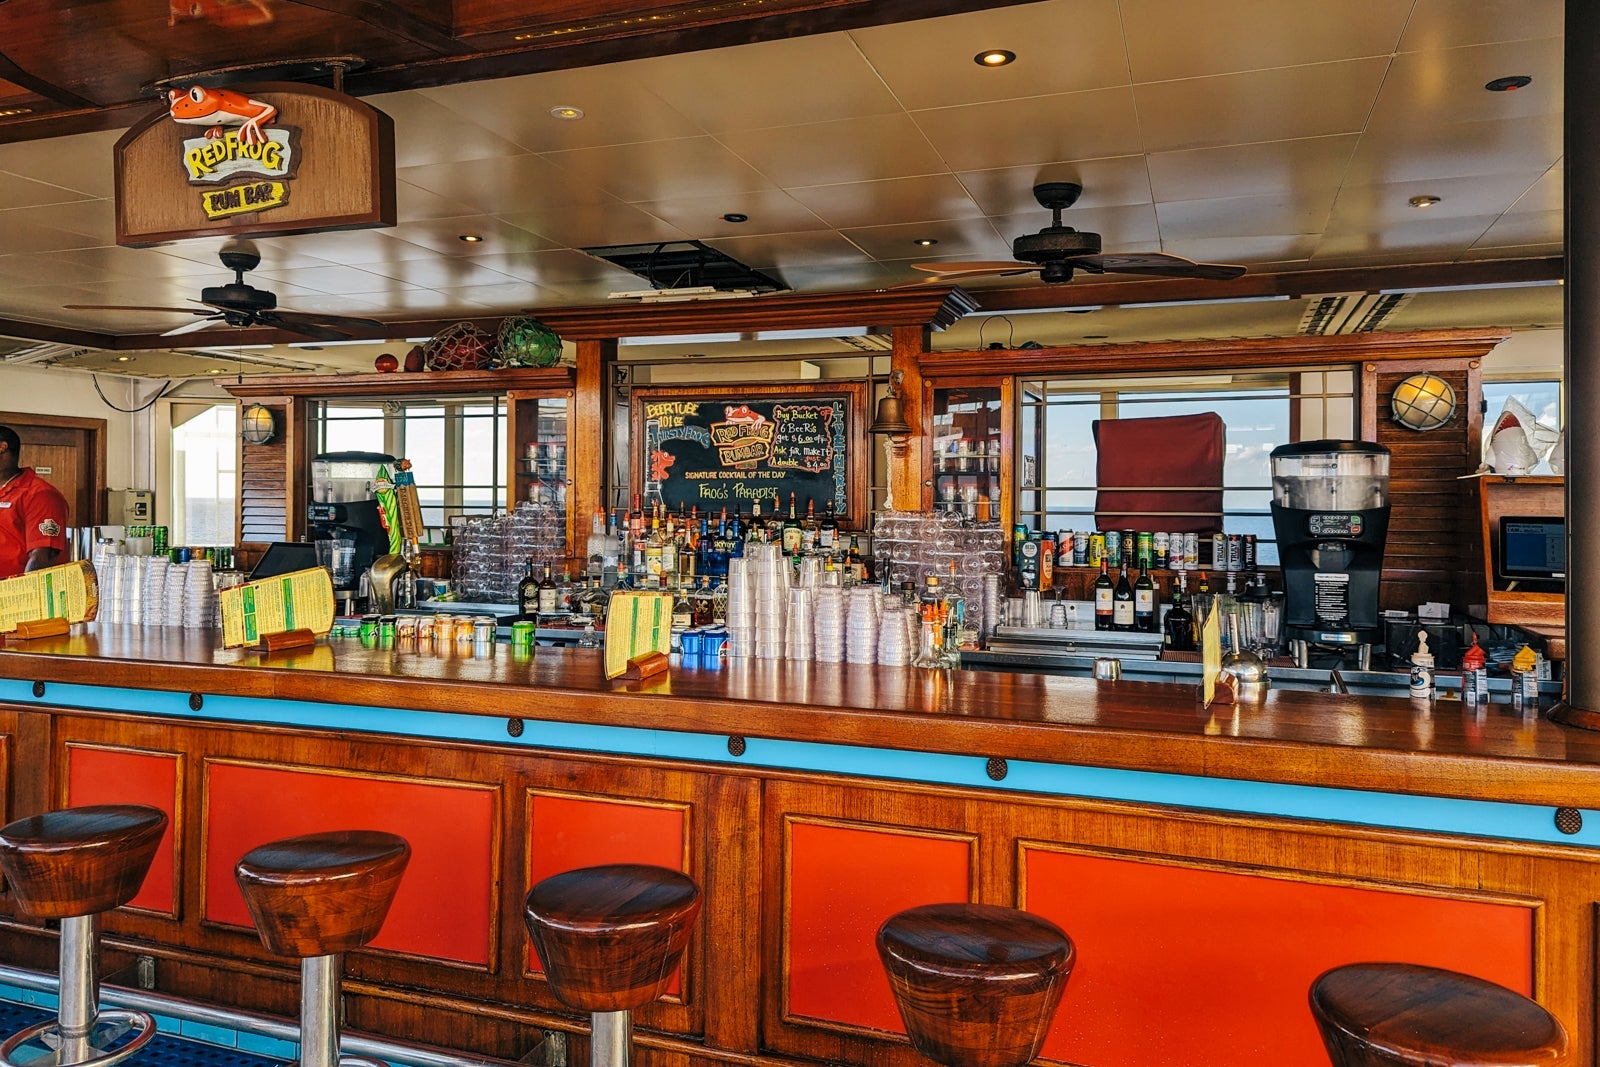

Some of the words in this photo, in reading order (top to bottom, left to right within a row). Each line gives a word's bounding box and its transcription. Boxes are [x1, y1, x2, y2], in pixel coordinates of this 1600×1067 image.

[210, 190, 241, 211] RUM
[243, 183, 275, 205] BAR
[776, 410, 790, 423] Buy
[791, 410, 818, 421] Bucket
[685, 471, 717, 479] SIGNATURE
[718, 471, 747, 479] COCKTAIL
[747, 471, 757, 479] OF
[758, 471, 771, 479] THE
[771, 471, 786, 479] DAY
